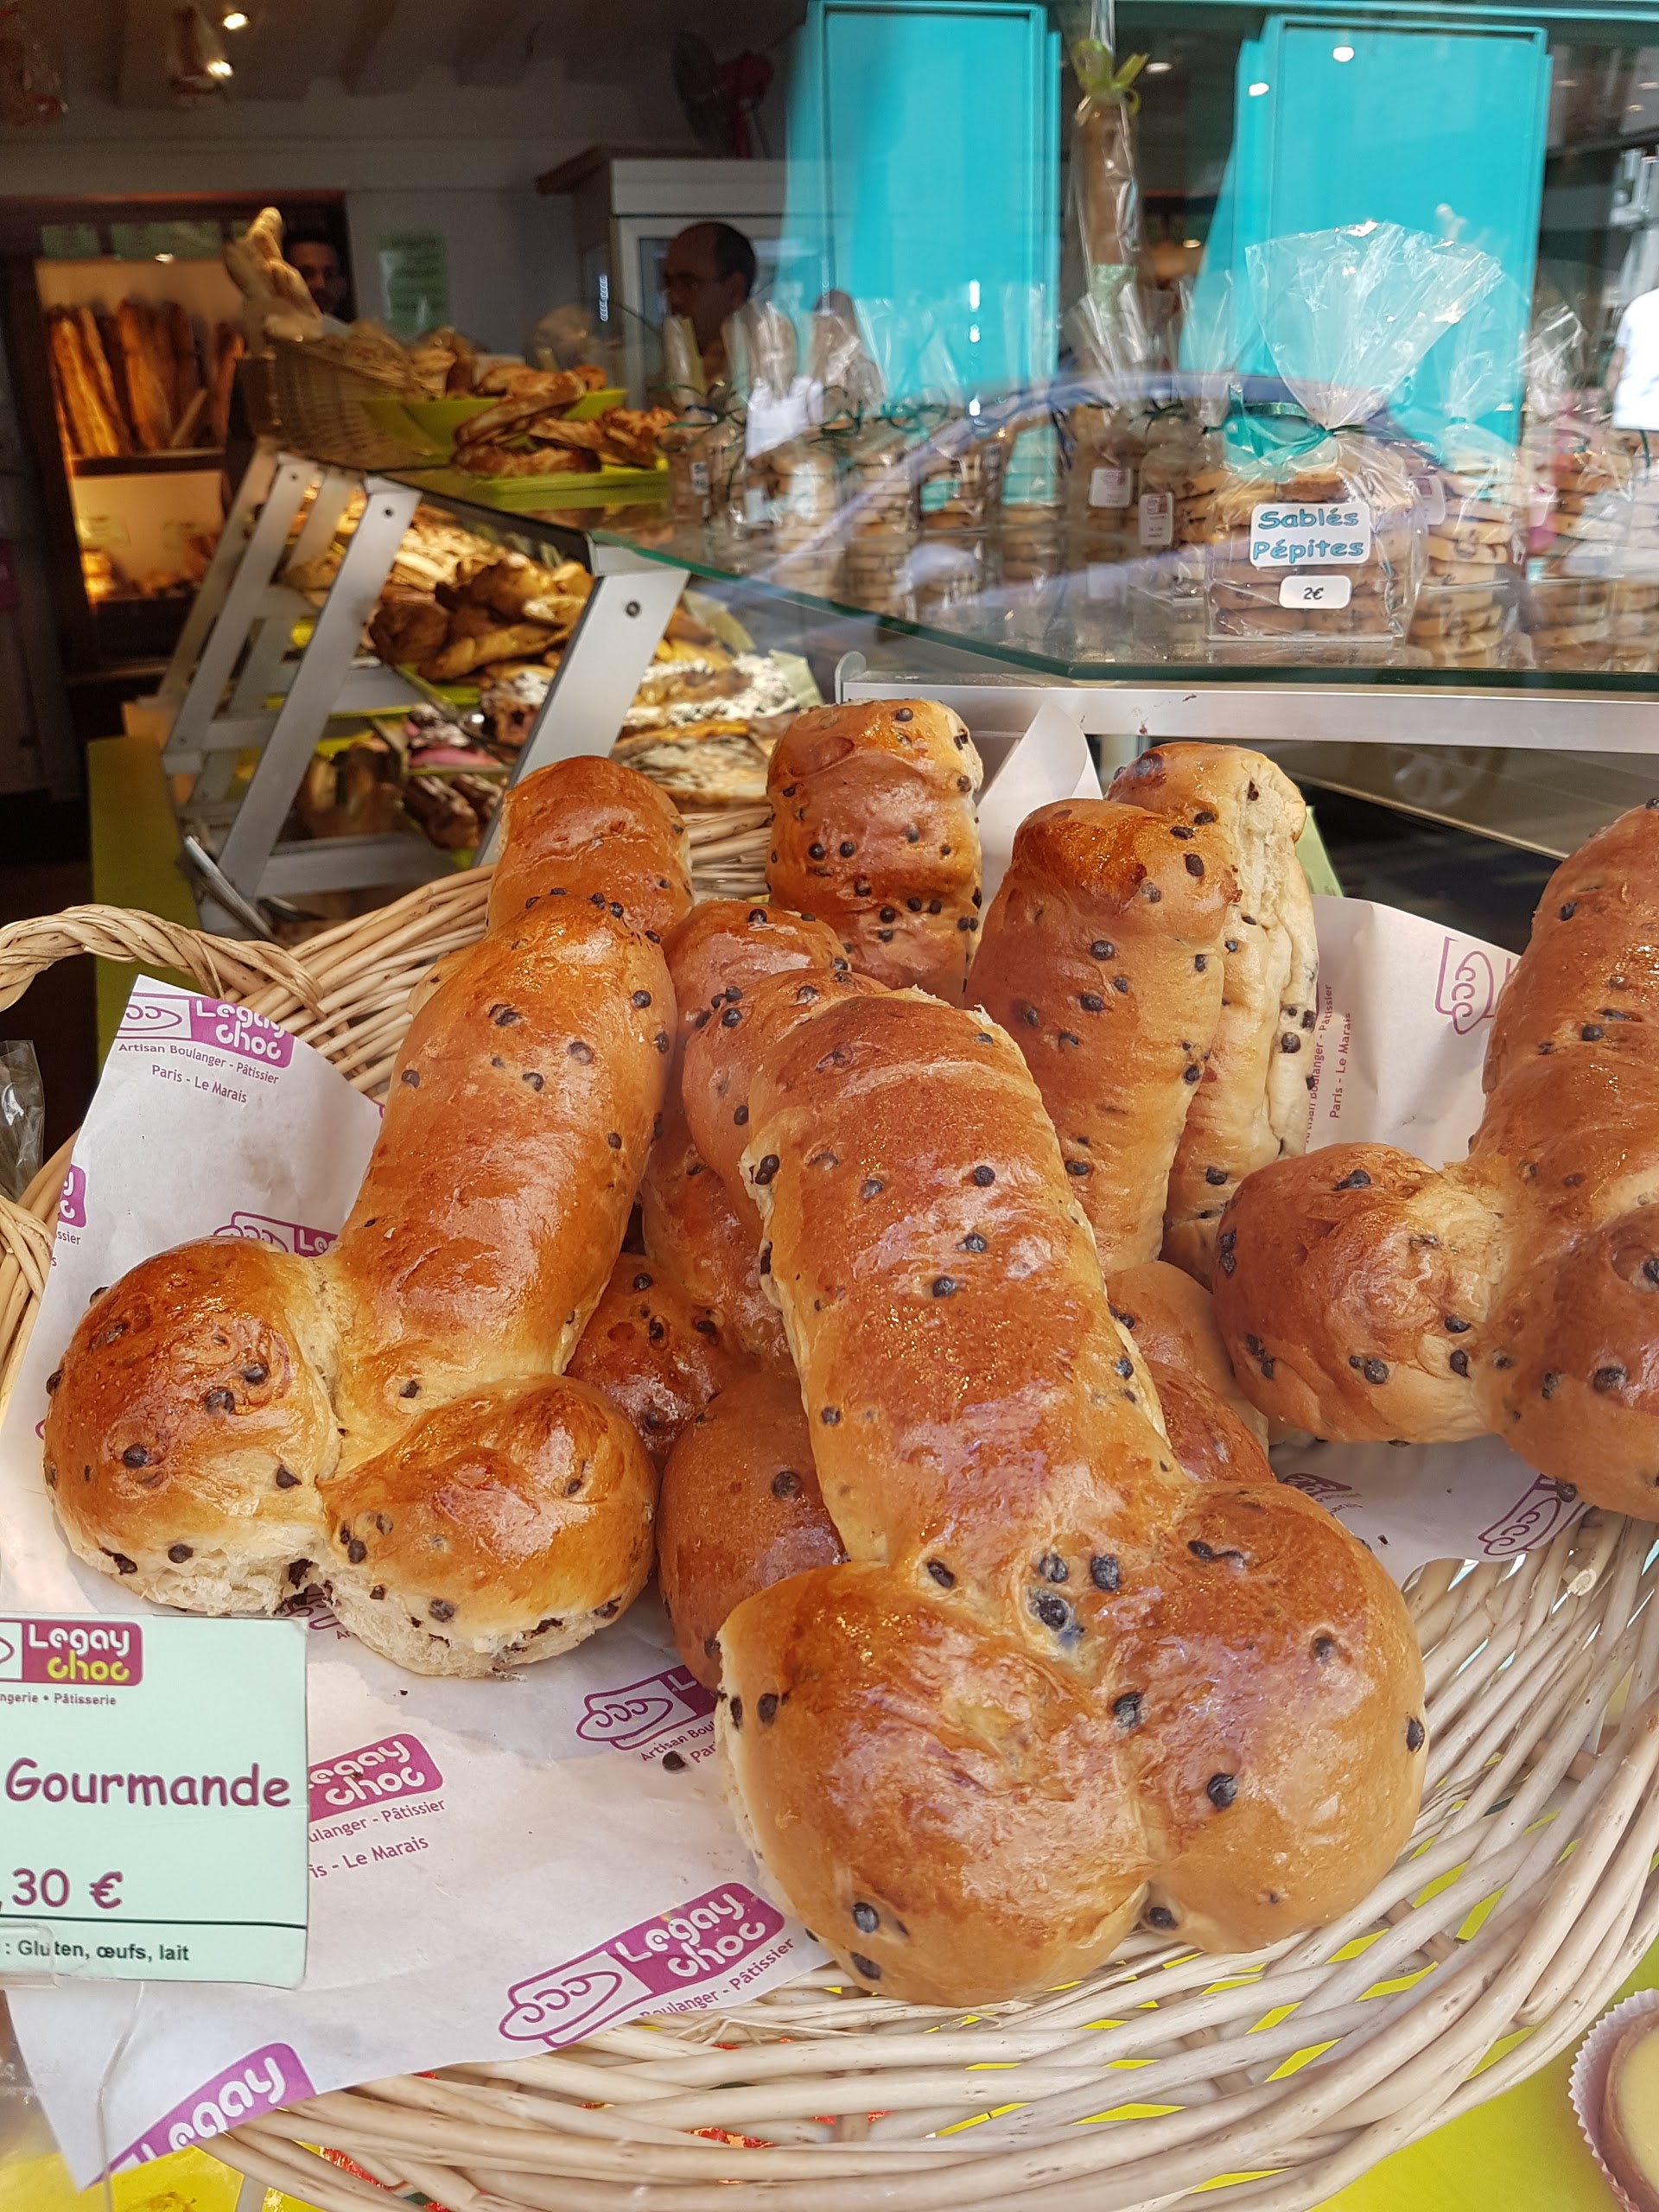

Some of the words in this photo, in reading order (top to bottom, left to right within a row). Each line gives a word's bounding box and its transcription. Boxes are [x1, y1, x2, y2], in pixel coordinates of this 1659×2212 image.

[1257, 508, 1359, 530] Sablés
[1253, 539, 1364, 563] Pépites
[1303, 587, 1325, 601] 2€
[1319, 984, 1333, 1031] Pâtissier
[215, 1020, 282, 1059] choc
[118, 1043, 165, 1053] Artisan
[169, 1045, 226, 1067] Boulanger
[236, 1062, 280, 1084] Pâtissier
[1335, 1058, 1346, 1074] Le
[151, 1065, 182, 1083] Paris
[194, 1076, 209, 1090] Le
[212, 1081, 248, 1103] Marais
[1329, 1087, 1343, 1119] Paris
[29, 1624, 130, 1657] Legay
[47, 1649, 130, 1681] choc
[54, 1693, 118, 1706] Pâtisserie
[640, 1734, 688, 1761] Artisan
[308, 1740, 411, 1789] egay
[6, 1757, 291, 1807] Gourmande
[325, 1767, 425, 1806] choc
[380, 1799, 446, 1823] Pâtissier
[342, 1854, 368, 1869] Le
[371, 1836, 429, 1861] Marais
[88, 1871, 124, 1910] €
[614, 1893, 745, 1963] Legay
[17, 1940, 90, 1960] Gluten,
[96, 1943, 153, 1963] œufs,
[159, 1944, 190, 1961] lait
[667, 1922, 766, 1978] choc
[728, 1936, 794, 1991] Pâtissier
